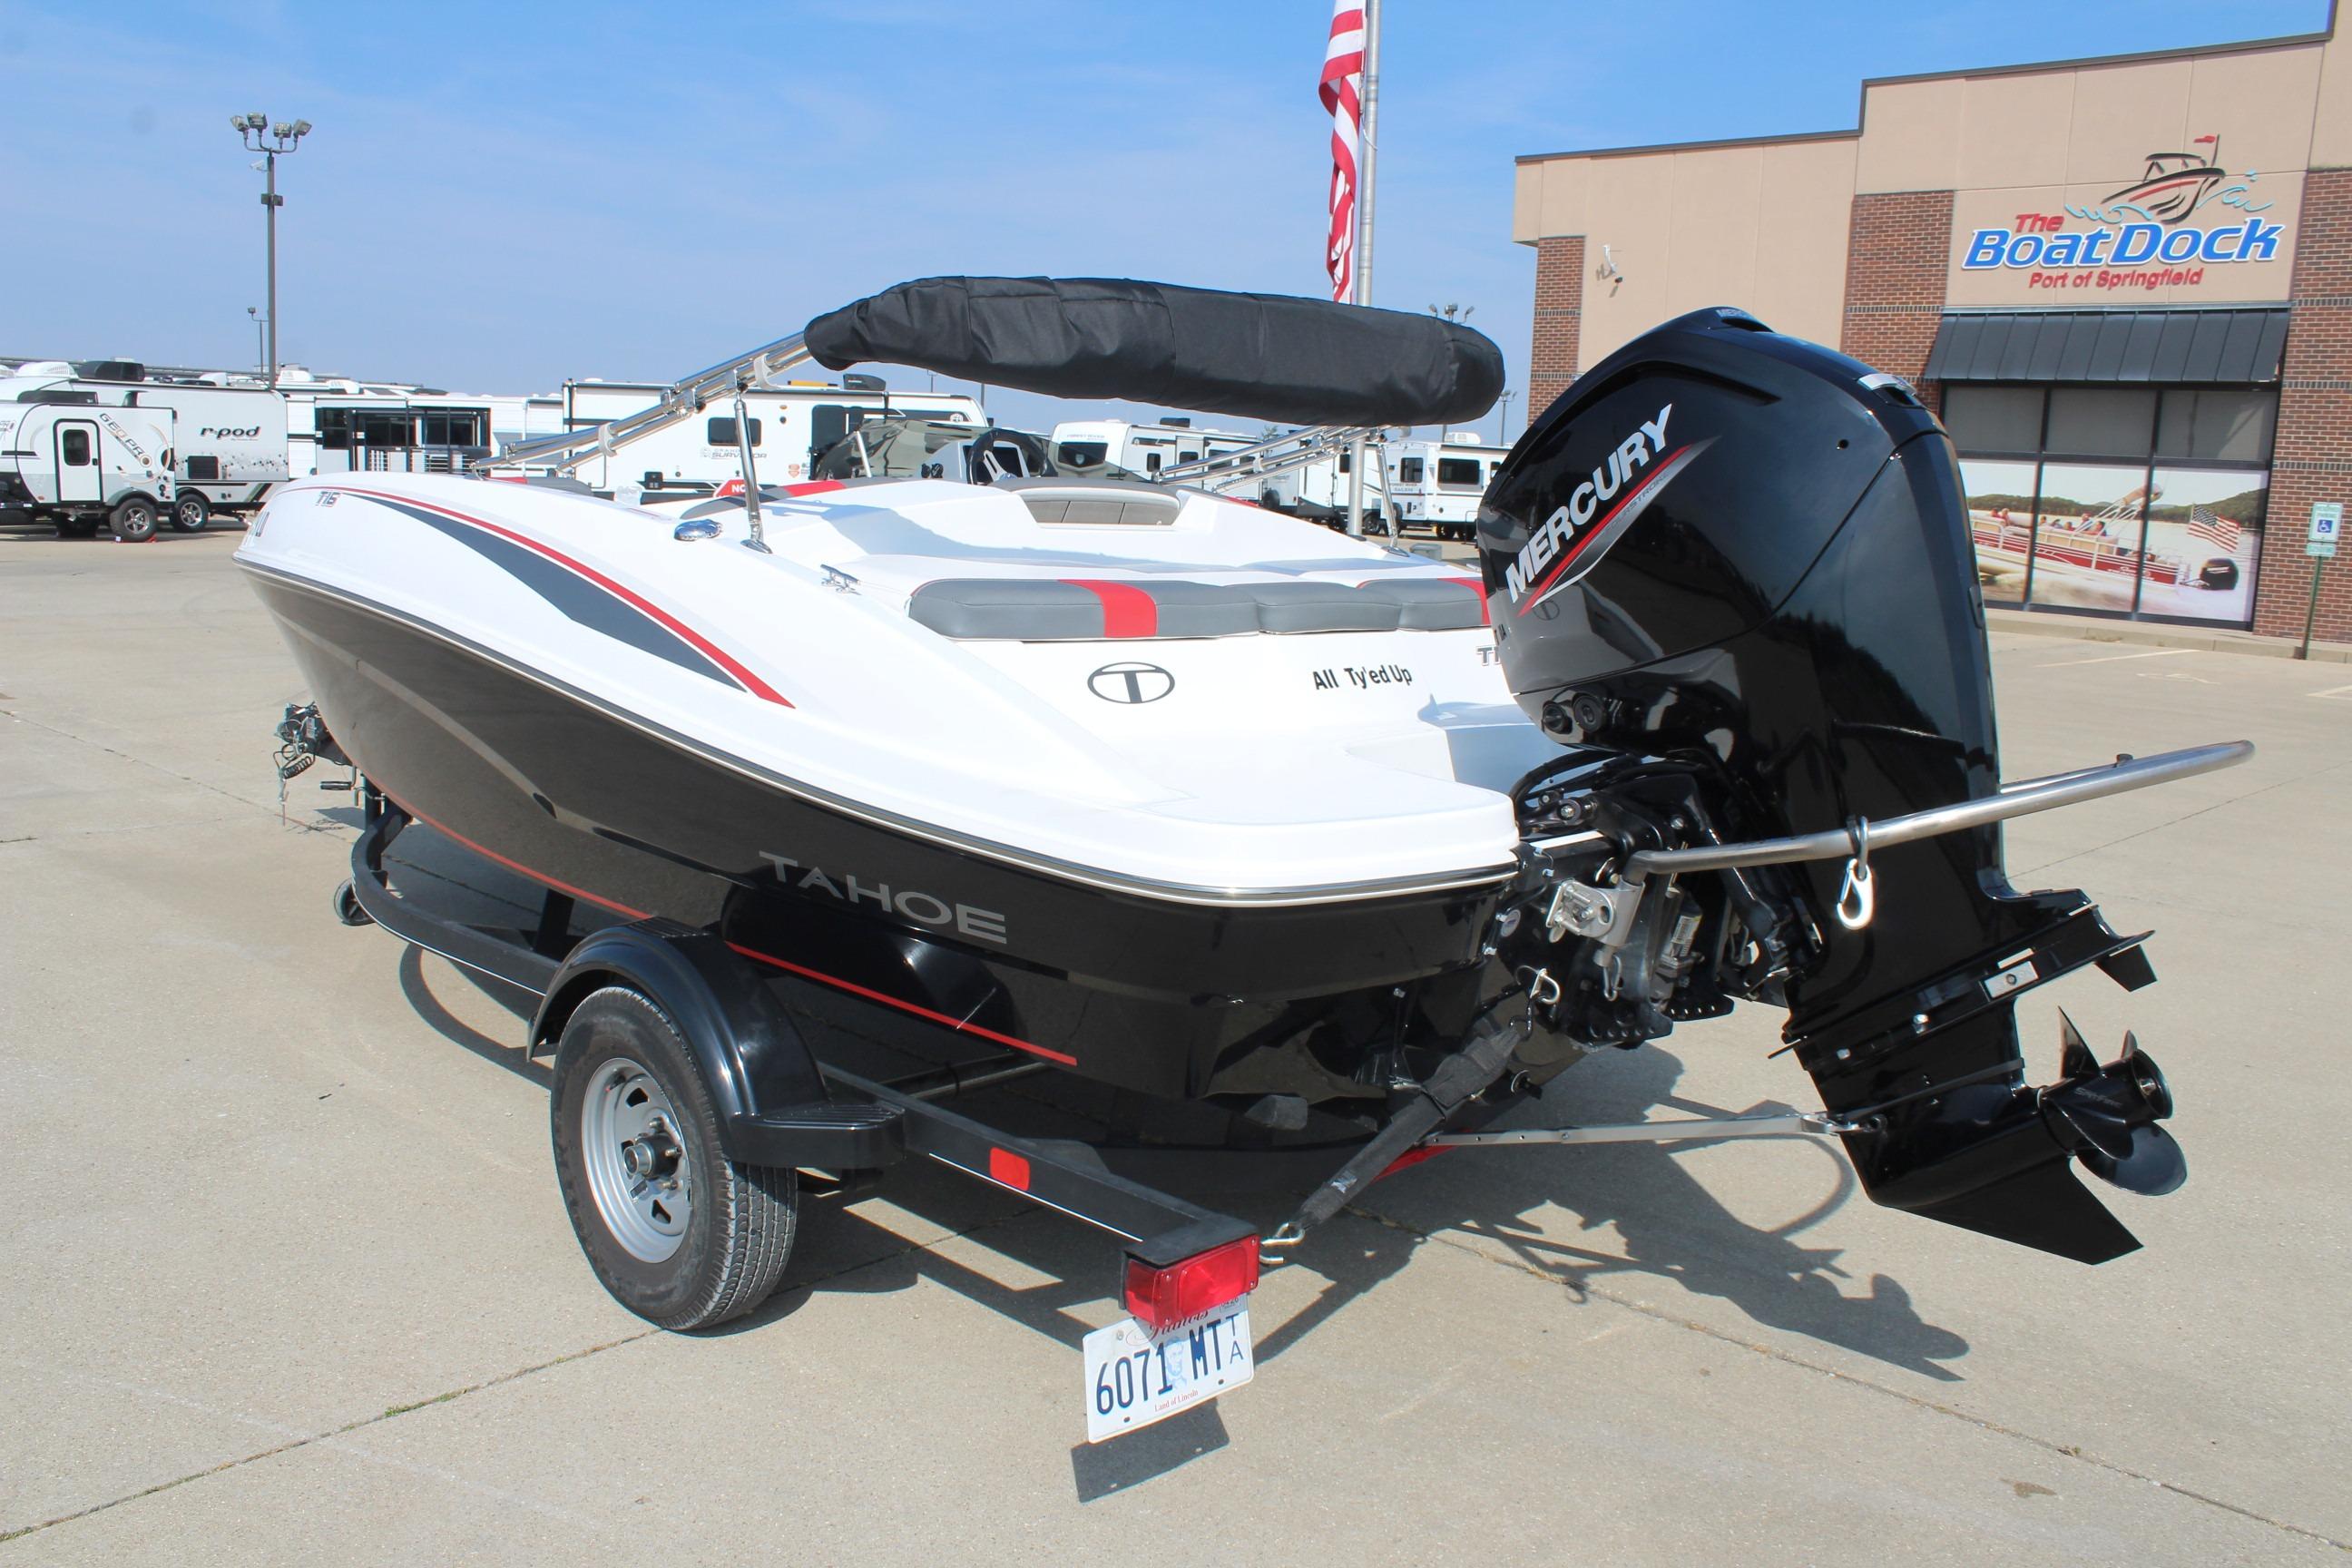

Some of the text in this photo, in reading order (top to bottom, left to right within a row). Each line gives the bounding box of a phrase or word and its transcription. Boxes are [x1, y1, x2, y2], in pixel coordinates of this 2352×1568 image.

[2015, 213, 2064, 233] The
[2029, 268, 2204, 290] Port of Springfield
[1505, 404, 1671, 603] MERCURY
[1312, 669, 1339, 690] All
[759, 849, 1007, 944] TAHOE
[1096, 1318, 1222, 1416] 6071 MT
[1154, 1387, 1199, 1413] Land of Lincoln
